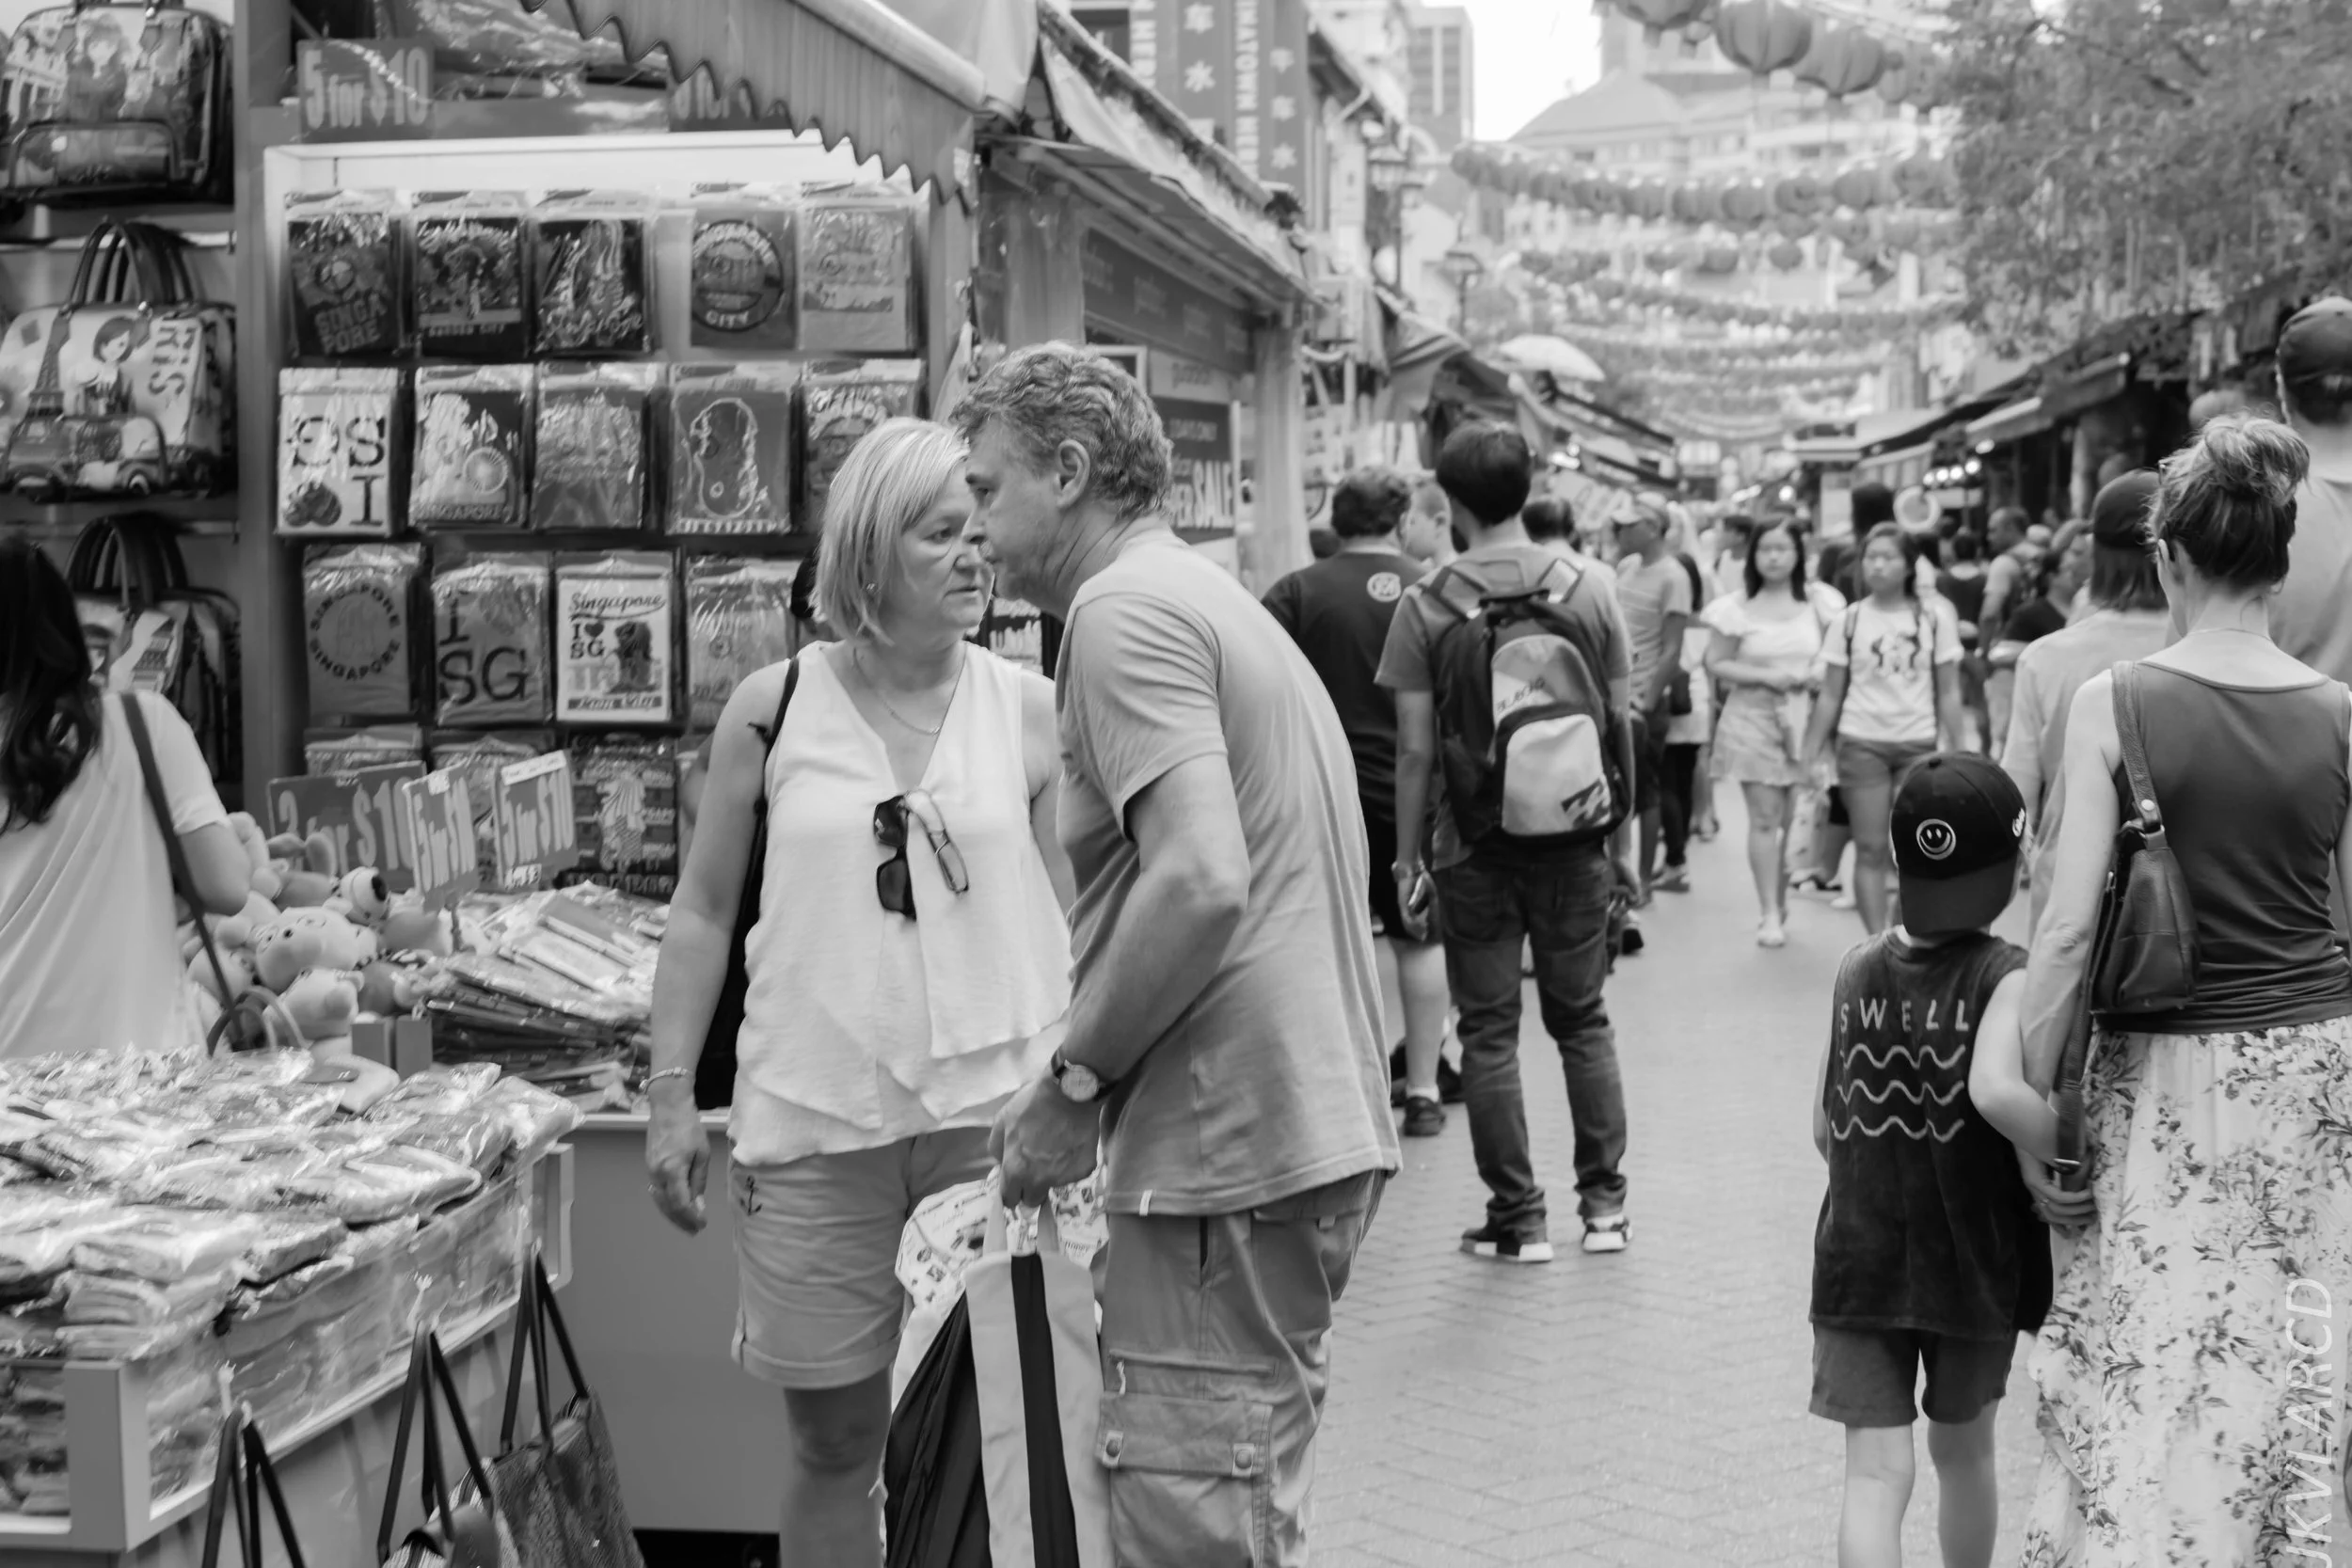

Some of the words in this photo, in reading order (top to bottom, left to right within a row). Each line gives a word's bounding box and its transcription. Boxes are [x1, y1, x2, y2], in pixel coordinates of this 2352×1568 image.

[306, 49, 324, 130] 5
[329, 73, 364, 129] for
[368, 46, 428, 128] $10
[705, 308, 750, 328] CITY
[569, 592, 665, 615] Singapore
[571, 623, 581, 641] I
[570, 640, 605, 659] SG
[437, 647, 530, 705] SG
[352, 776, 414, 872] $10
[1839, 997, 1969, 1033] SWELL
